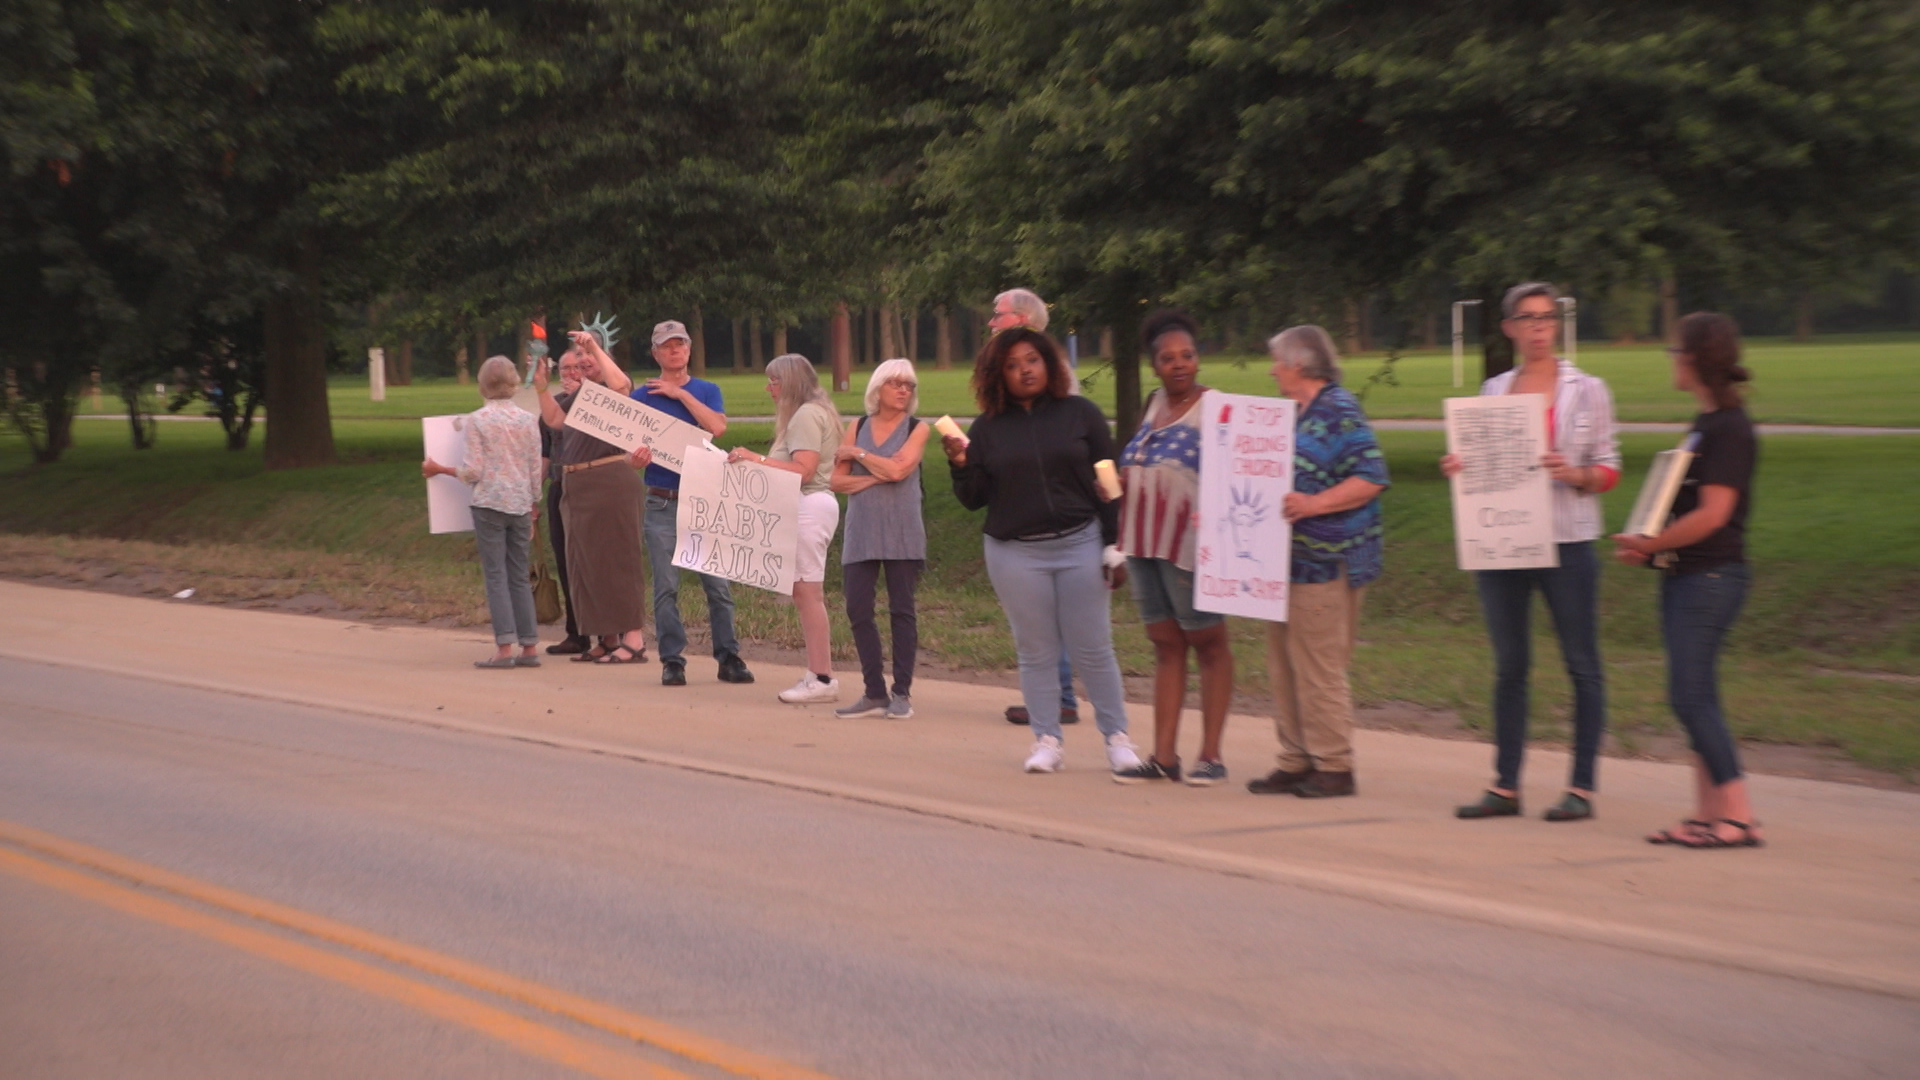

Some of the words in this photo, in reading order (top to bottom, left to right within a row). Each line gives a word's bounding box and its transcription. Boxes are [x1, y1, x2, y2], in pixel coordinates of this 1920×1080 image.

[582, 389, 661, 433] SEPARATING
[1245, 404, 1284, 427] STOP
[720, 461, 769, 504] NO
[688, 495, 781, 548] BABY
[680, 533, 783, 588] JAILS
